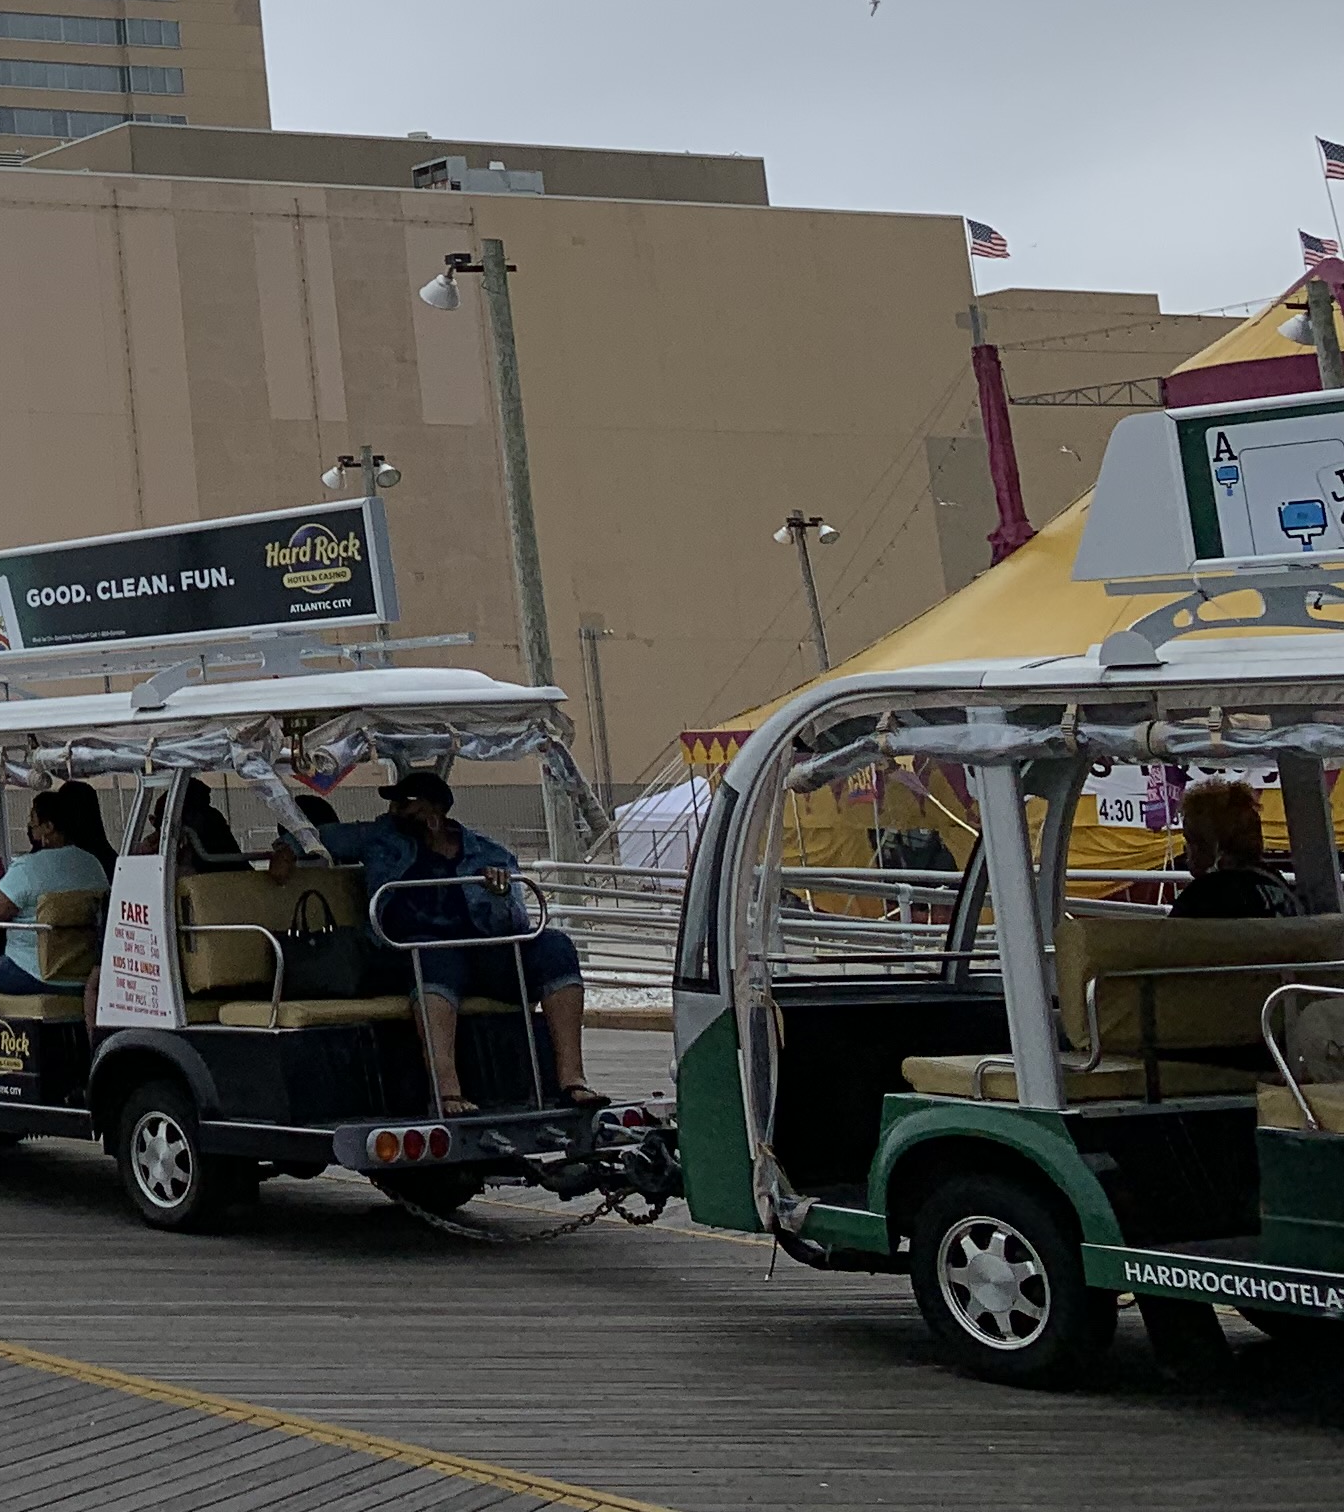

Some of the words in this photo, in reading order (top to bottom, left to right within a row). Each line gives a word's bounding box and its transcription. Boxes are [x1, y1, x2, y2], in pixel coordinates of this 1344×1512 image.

[1213, 431, 1238, 463] A
[265, 537, 312, 568] Hard
[314, 531, 362, 565] Rock
[26, 584, 91, 607] GOOD.
[96, 574, 176, 600] CLEAN.
[180, 567, 235, 591] FUN.
[287, 574, 310, 585] HOTEL
[312, 574, 318, 582] &
[318, 570, 347, 580] CASINO
[289, 601, 331, 613] ATLANTIC
[332, 598, 352, 609] CITY
[1099, 797, 1134, 822] 4:30
[121, 900, 149, 925] FARE
[113, 955, 126, 969] KIDS
[140, 961, 160, 977] UNDER
[0, 1030, 30, 1056] Rock
[9, 1086, 22, 1096] CITY
